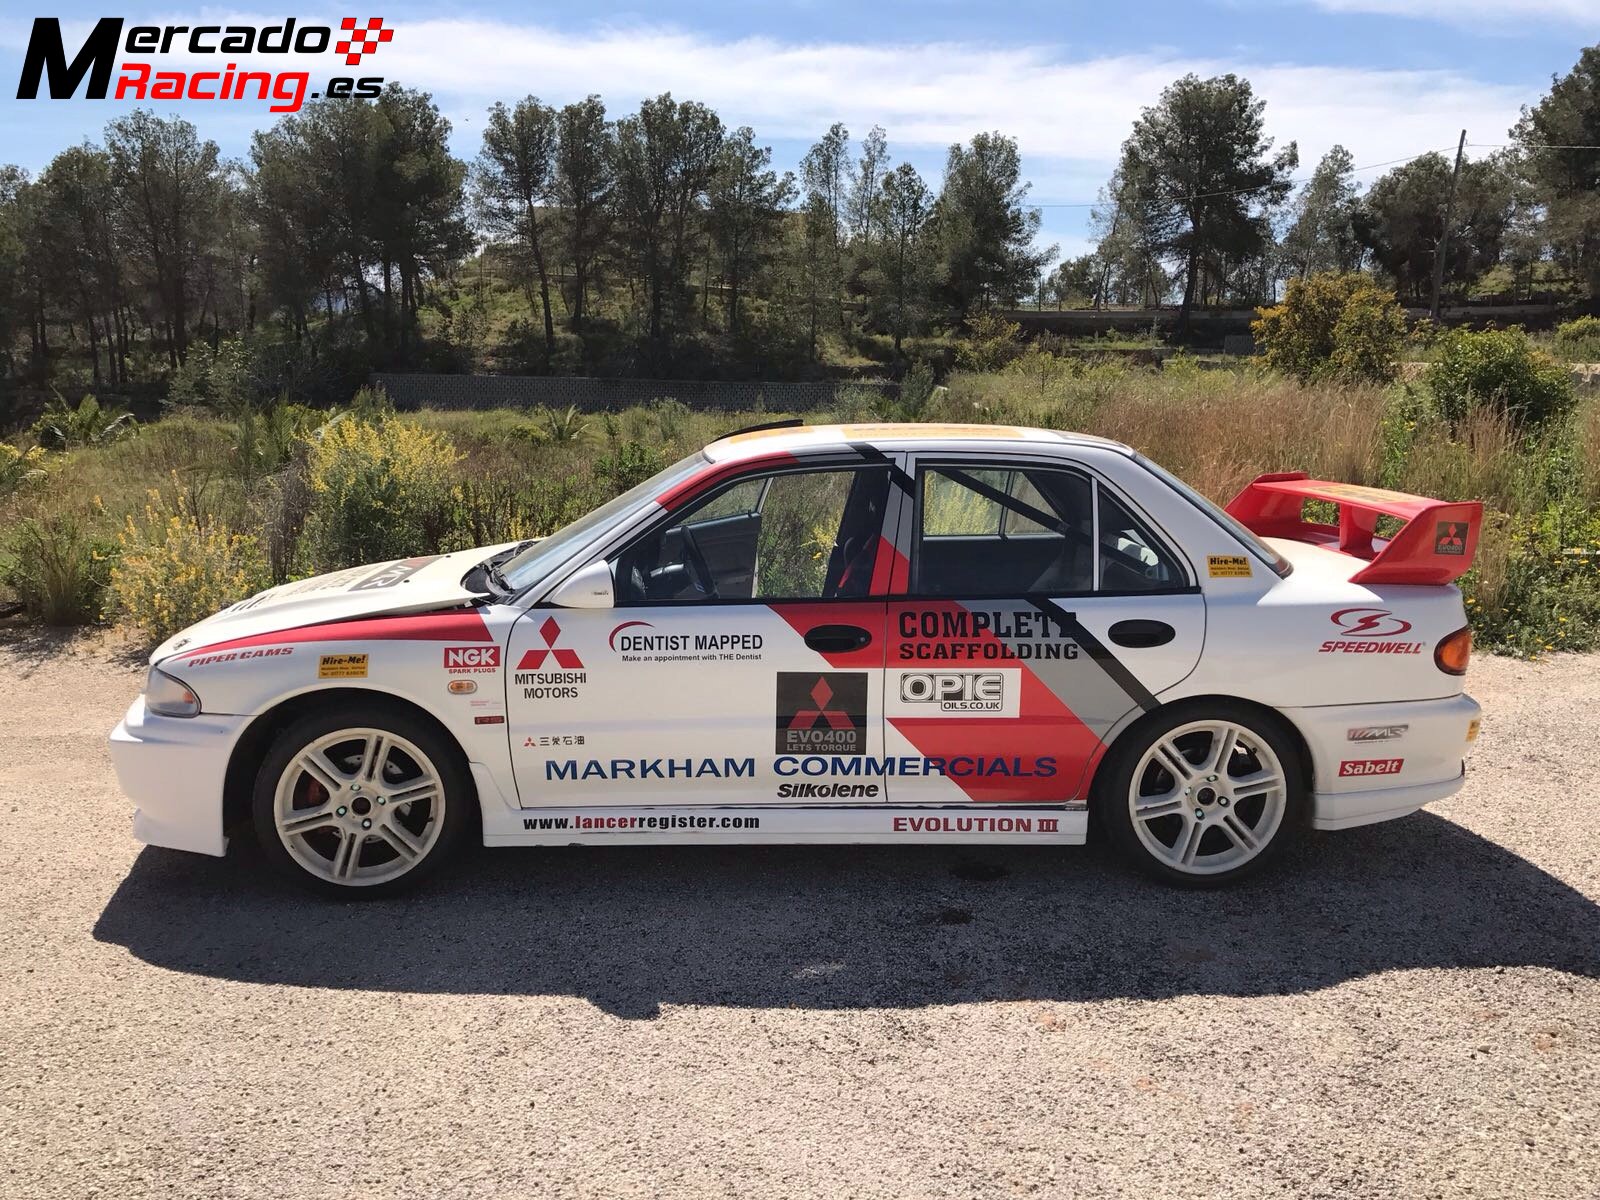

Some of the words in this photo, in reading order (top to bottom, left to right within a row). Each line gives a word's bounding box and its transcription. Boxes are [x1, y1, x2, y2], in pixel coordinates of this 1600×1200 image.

[1210, 557, 1247, 565] Hire-Me!
[620, 635, 690, 651] DENTIST
[695, 634, 763, 650] MAPPED
[1318, 641, 1422, 654] SPEEDWELL
[188, 653, 237, 667] PIPER
[239, 647, 294, 659] CAMS
[448, 648, 496, 666] NGK
[654, 654, 700, 662] appointment
[899, 643, 1078, 660] SCAFFOLDING
[322, 655, 366, 665] Hire-Me!
[514, 673, 587, 685] MITSUBISHI
[524, 687, 578, 699] MOTORS
[901, 673, 1003, 701] OPIE
[943, 701, 1000, 710] OILS.CO.UK
[786, 730, 857, 743] EVO400
[815, 744, 857, 752] TORQUE
[545, 758, 756, 781] MARKHAM
[773, 756, 1057, 777] COMMERCIALS
[1343, 760, 1399, 775] Sabelt
[777, 783, 879, 798] Silkolene
[523, 814, 760, 830] www.lancerregister.com
[893, 817, 1032, 833] EVOLUTION
[1037, 817, 1059, 833] III
